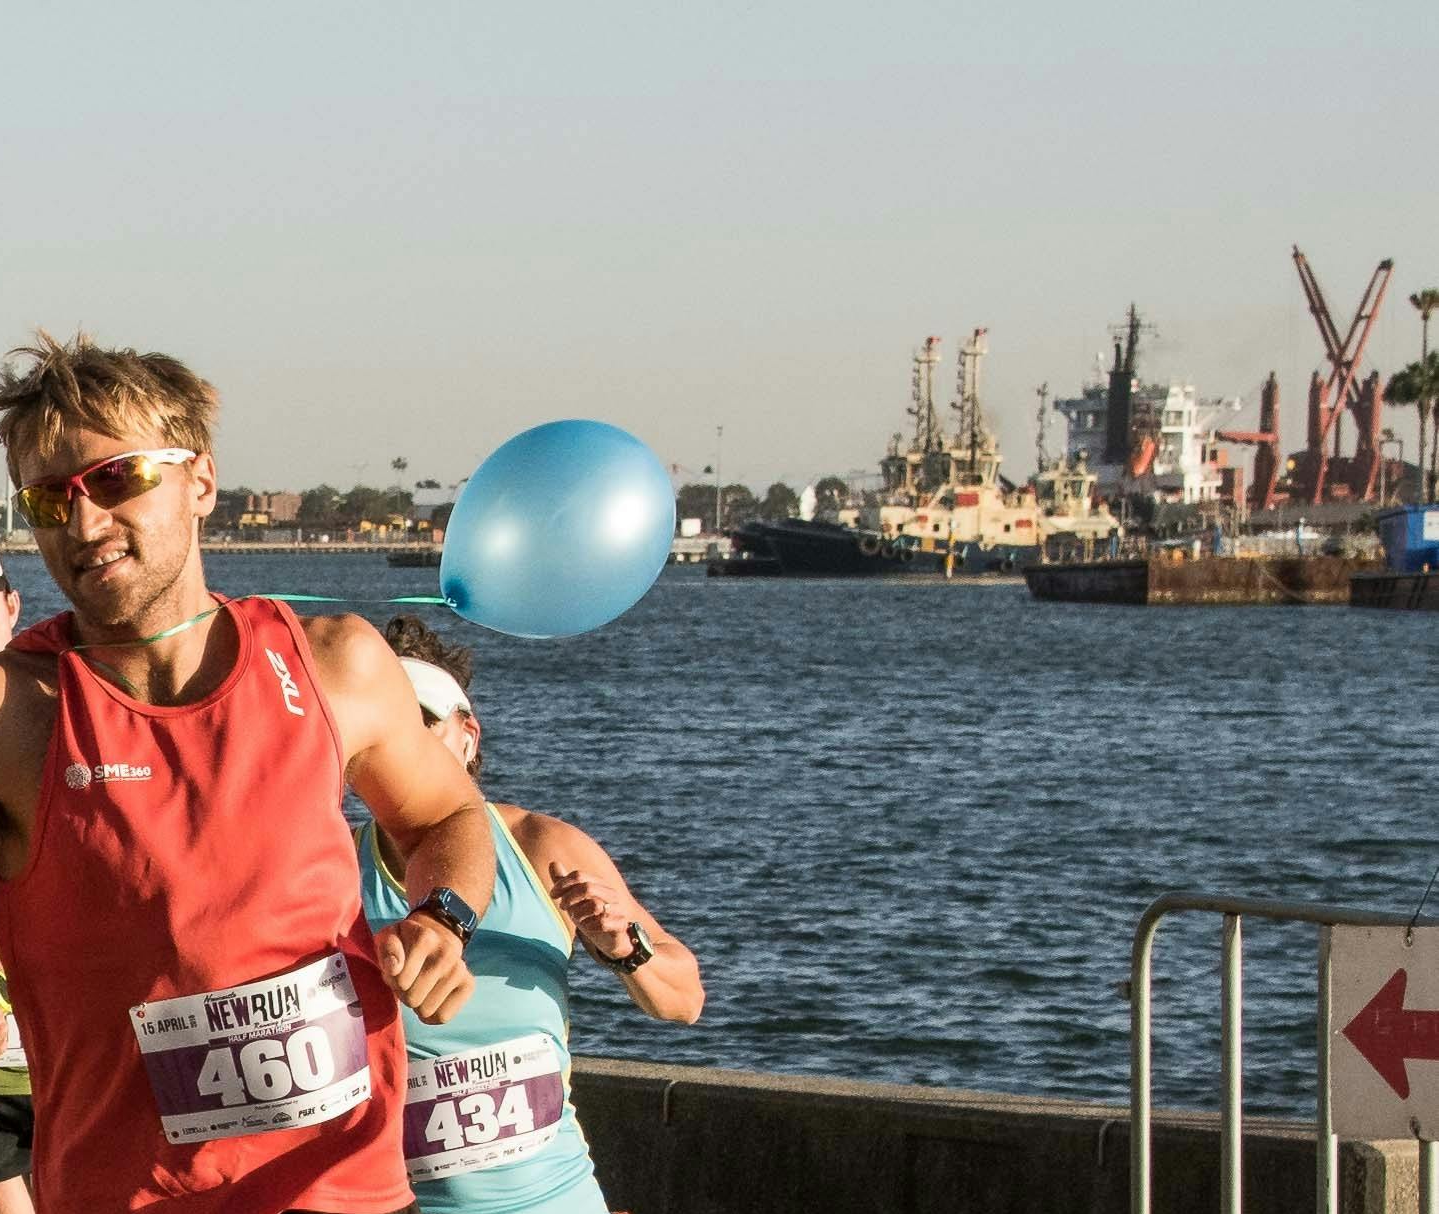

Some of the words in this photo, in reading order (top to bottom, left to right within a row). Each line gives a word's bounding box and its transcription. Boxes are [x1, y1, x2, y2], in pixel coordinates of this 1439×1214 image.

[94, 763, 152, 778] SME360
[141, 1022, 155, 1036] 15
[157, 1017, 189, 1034] APRIL
[228, 1034, 248, 1044] HALF
[249, 1024, 292, 1040] MARATHON
[196, 1025, 336, 1107] 460
[407, 1077, 421, 1089] RIL
[425, 1084, 536, 1151] 434
